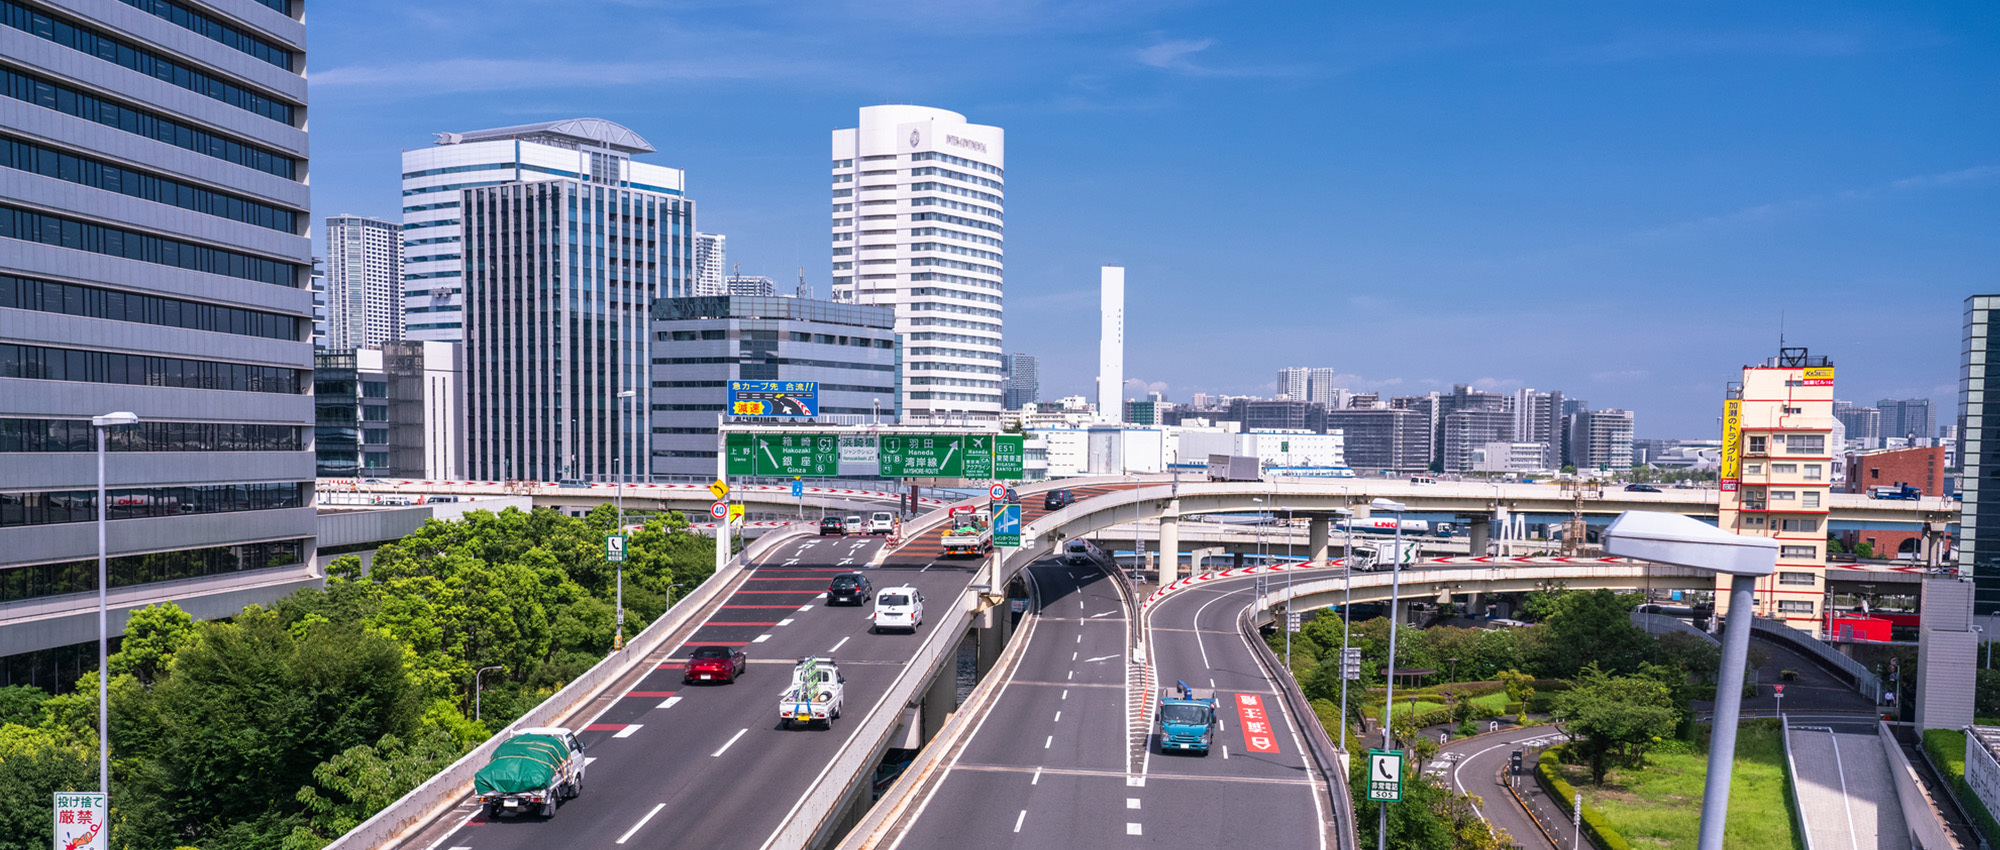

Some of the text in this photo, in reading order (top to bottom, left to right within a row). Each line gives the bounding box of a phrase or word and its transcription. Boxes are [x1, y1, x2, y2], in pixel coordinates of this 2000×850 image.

[732, 382, 814, 391] 急カーブ先 合流!!
[737, 403, 760, 414] 減速
[782, 436, 811, 446] 箱崎
[819, 438, 831, 448] C1
[909, 438, 934, 449] 羽田
[1726, 402, 1738, 478] 加瀬のトランクルーム
[730, 447, 750, 455] 上野
[782, 456, 811, 467] 銀座
[905, 457, 938, 467] 湾岸線
[993, 488, 1003, 496] 40
[714, 506, 724, 514] 40
[58, 796, 103, 808] 投げ捨て
[58, 810, 93, 824] 厳禁
